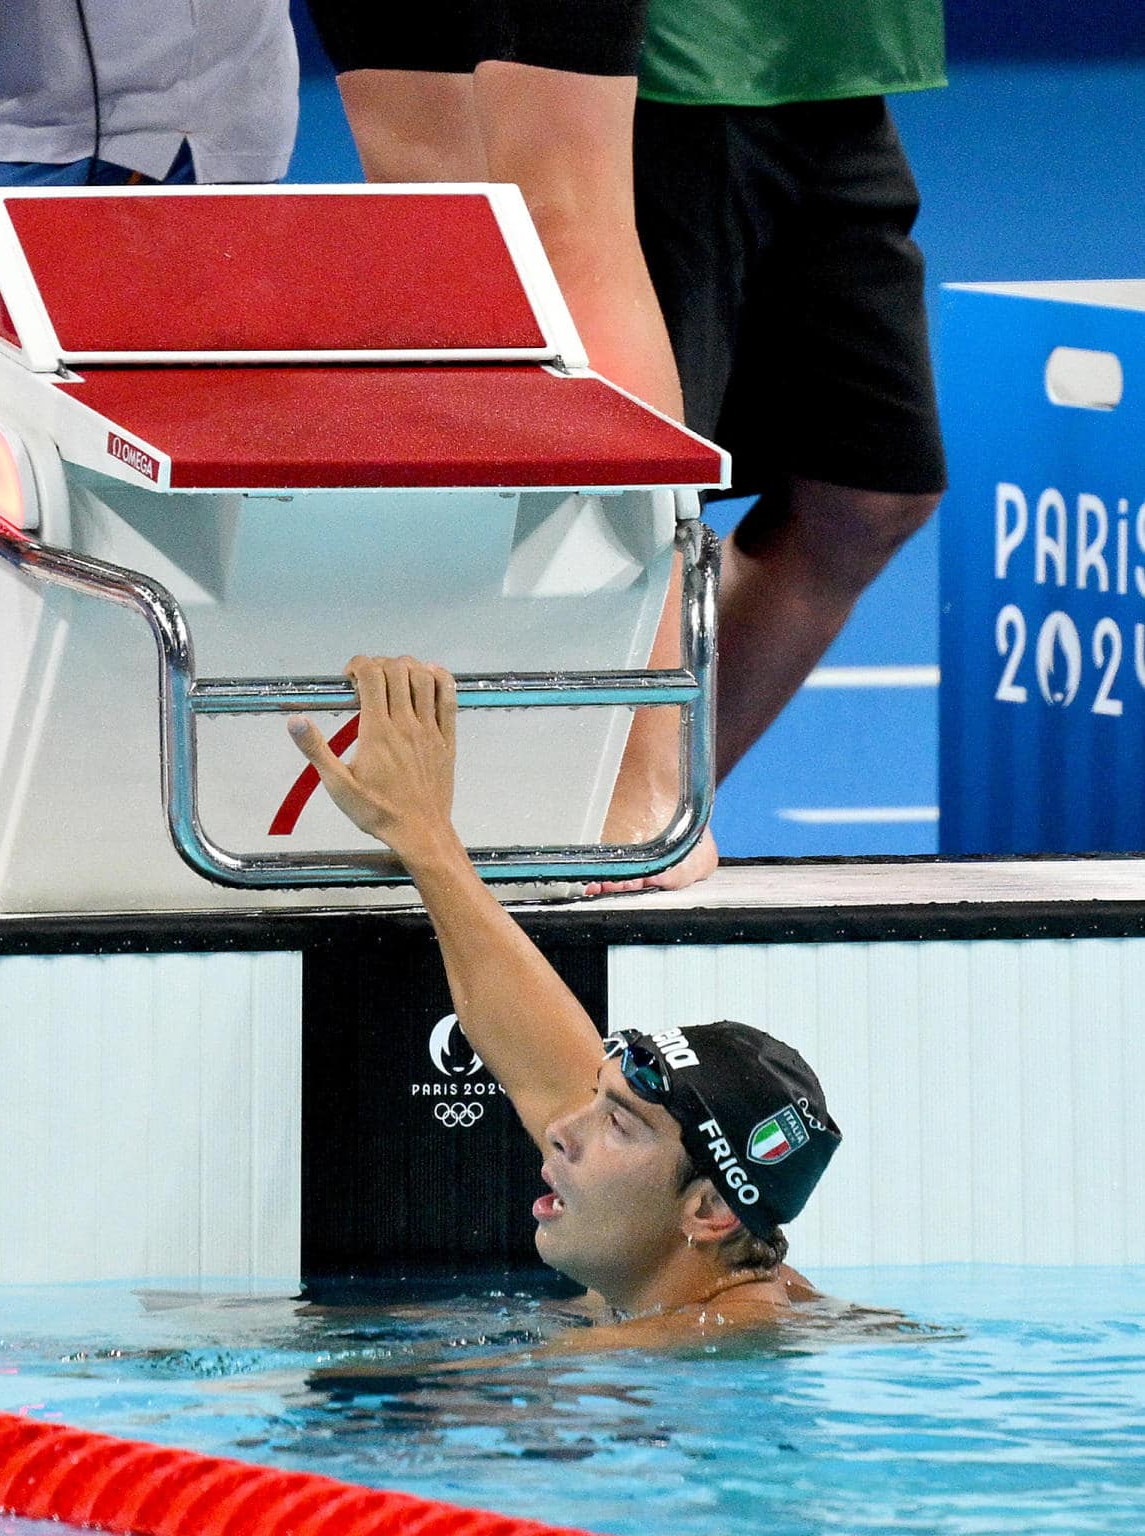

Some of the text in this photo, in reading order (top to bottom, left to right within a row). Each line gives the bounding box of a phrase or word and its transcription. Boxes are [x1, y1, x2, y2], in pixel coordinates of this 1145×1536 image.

[121, 444, 154, 480] OMEGA
[411, 1083, 458, 1096] PARIS
[783, 1110, 805, 1144] ITALIA
[697, 1118, 760, 1206] FRIGO
